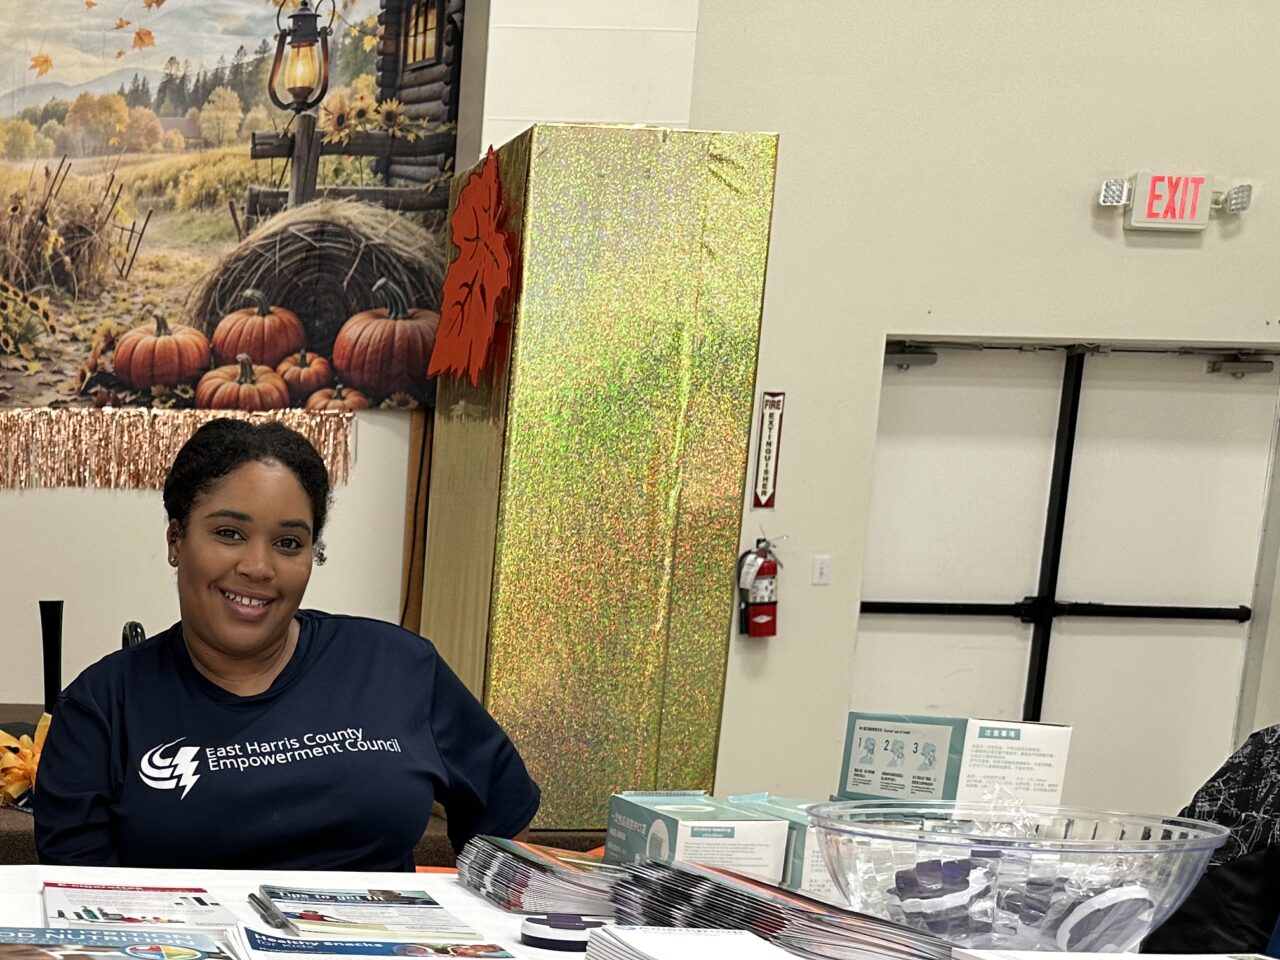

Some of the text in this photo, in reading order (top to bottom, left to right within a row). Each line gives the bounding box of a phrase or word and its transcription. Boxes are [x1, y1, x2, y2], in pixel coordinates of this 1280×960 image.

[1146, 176, 1204, 220] EXIT
[765, 400, 782, 410] FIRE
[761, 412, 775, 497] EXTINGUISHER
[206, 727, 364, 760] East Harris County
[858, 737, 862, 748] 1
[883, 740, 890, 751] 2
[912, 742, 919, 754] 3
[209, 738, 402, 772] Empowerment Council
[46, 933, 196, 946] NUTRITION
[254, 933, 319, 946] Healthy
